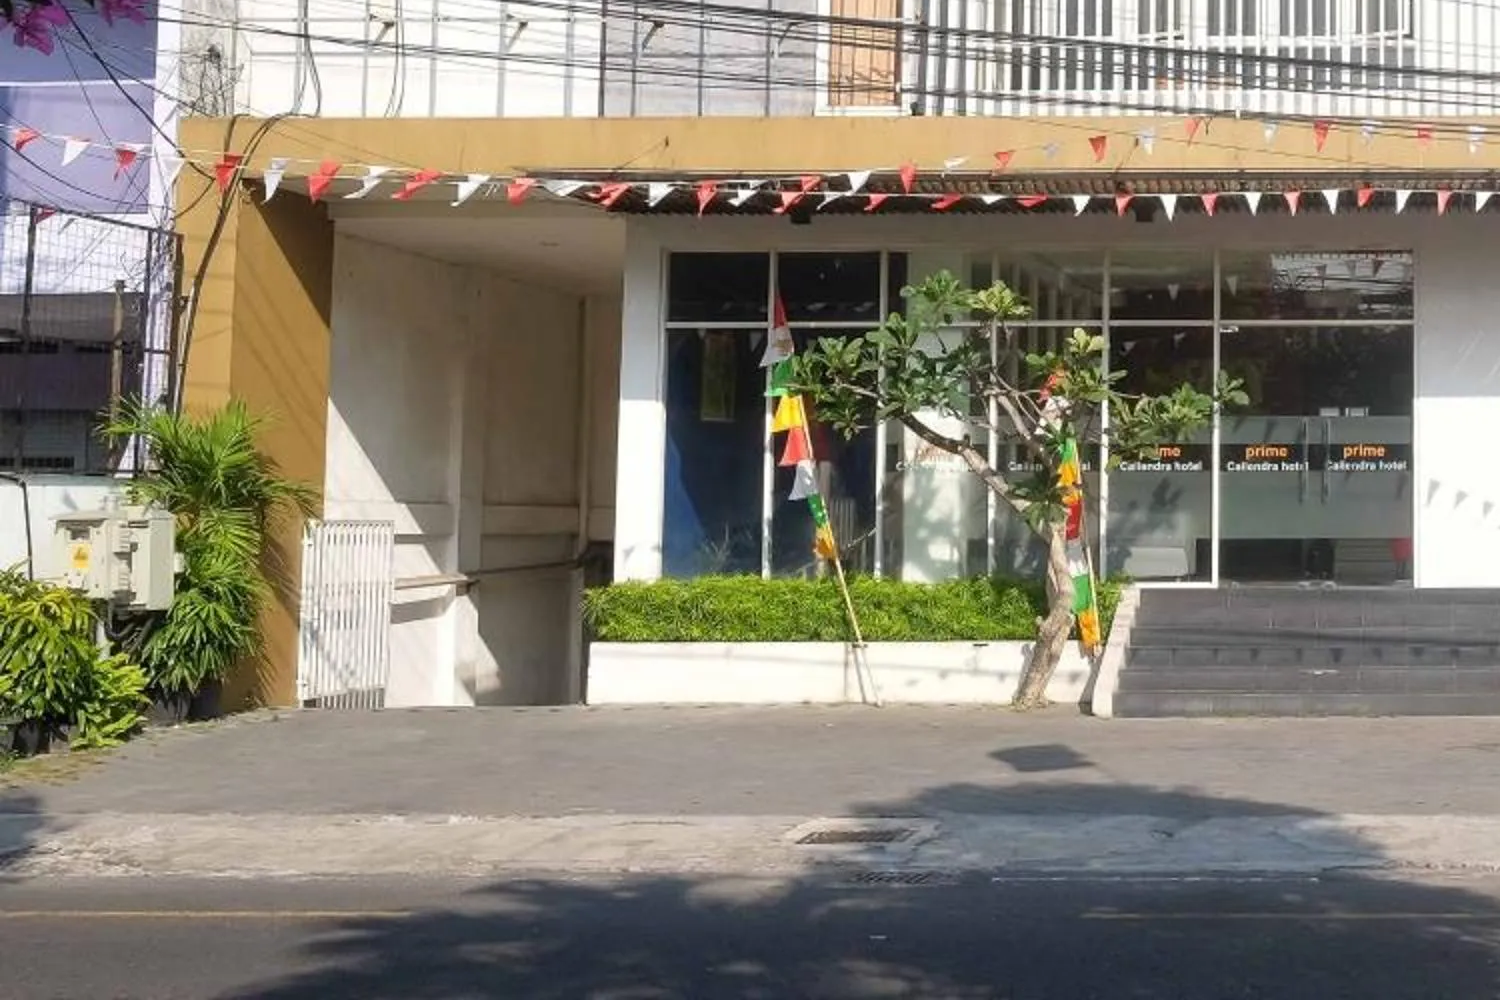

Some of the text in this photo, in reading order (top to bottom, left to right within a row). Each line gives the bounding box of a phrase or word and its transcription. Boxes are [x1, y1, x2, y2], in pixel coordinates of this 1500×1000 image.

[1246, 444, 1288, 460] prime
[1343, 444, 1385, 459] prime
[1174, 461, 1202, 472] hotel
[1227, 461, 1278, 472] Cailendra
[1379, 460, 1407, 471] hotel
